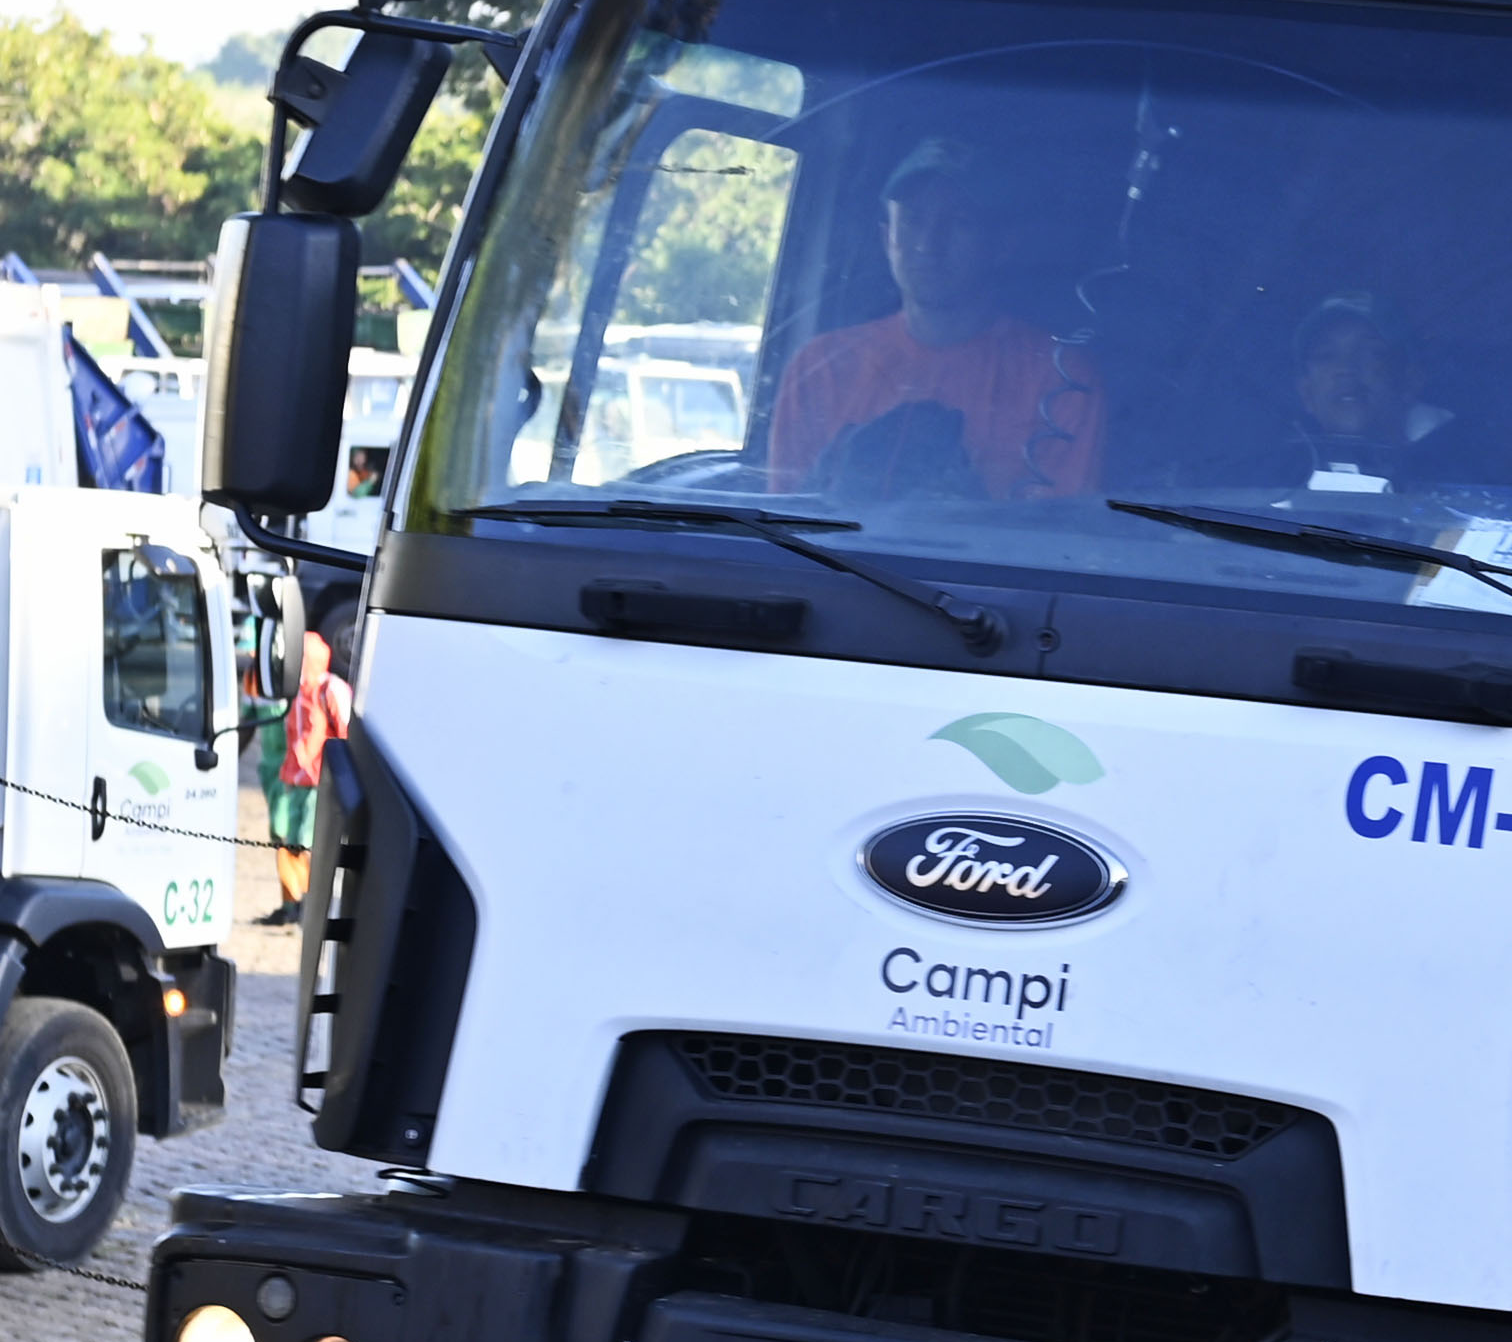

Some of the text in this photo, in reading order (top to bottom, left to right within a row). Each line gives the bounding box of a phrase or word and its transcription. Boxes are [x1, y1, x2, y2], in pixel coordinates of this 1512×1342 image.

[119, 797, 171, 820] Campi
[904, 826, 1061, 899] Ford
[163, 877, 215, 927] C-32
[881, 946, 1071, 1021] Campi
[887, 1006, 1055, 1049] Ambiental
[775, 1170, 1126, 1256] CARGO
